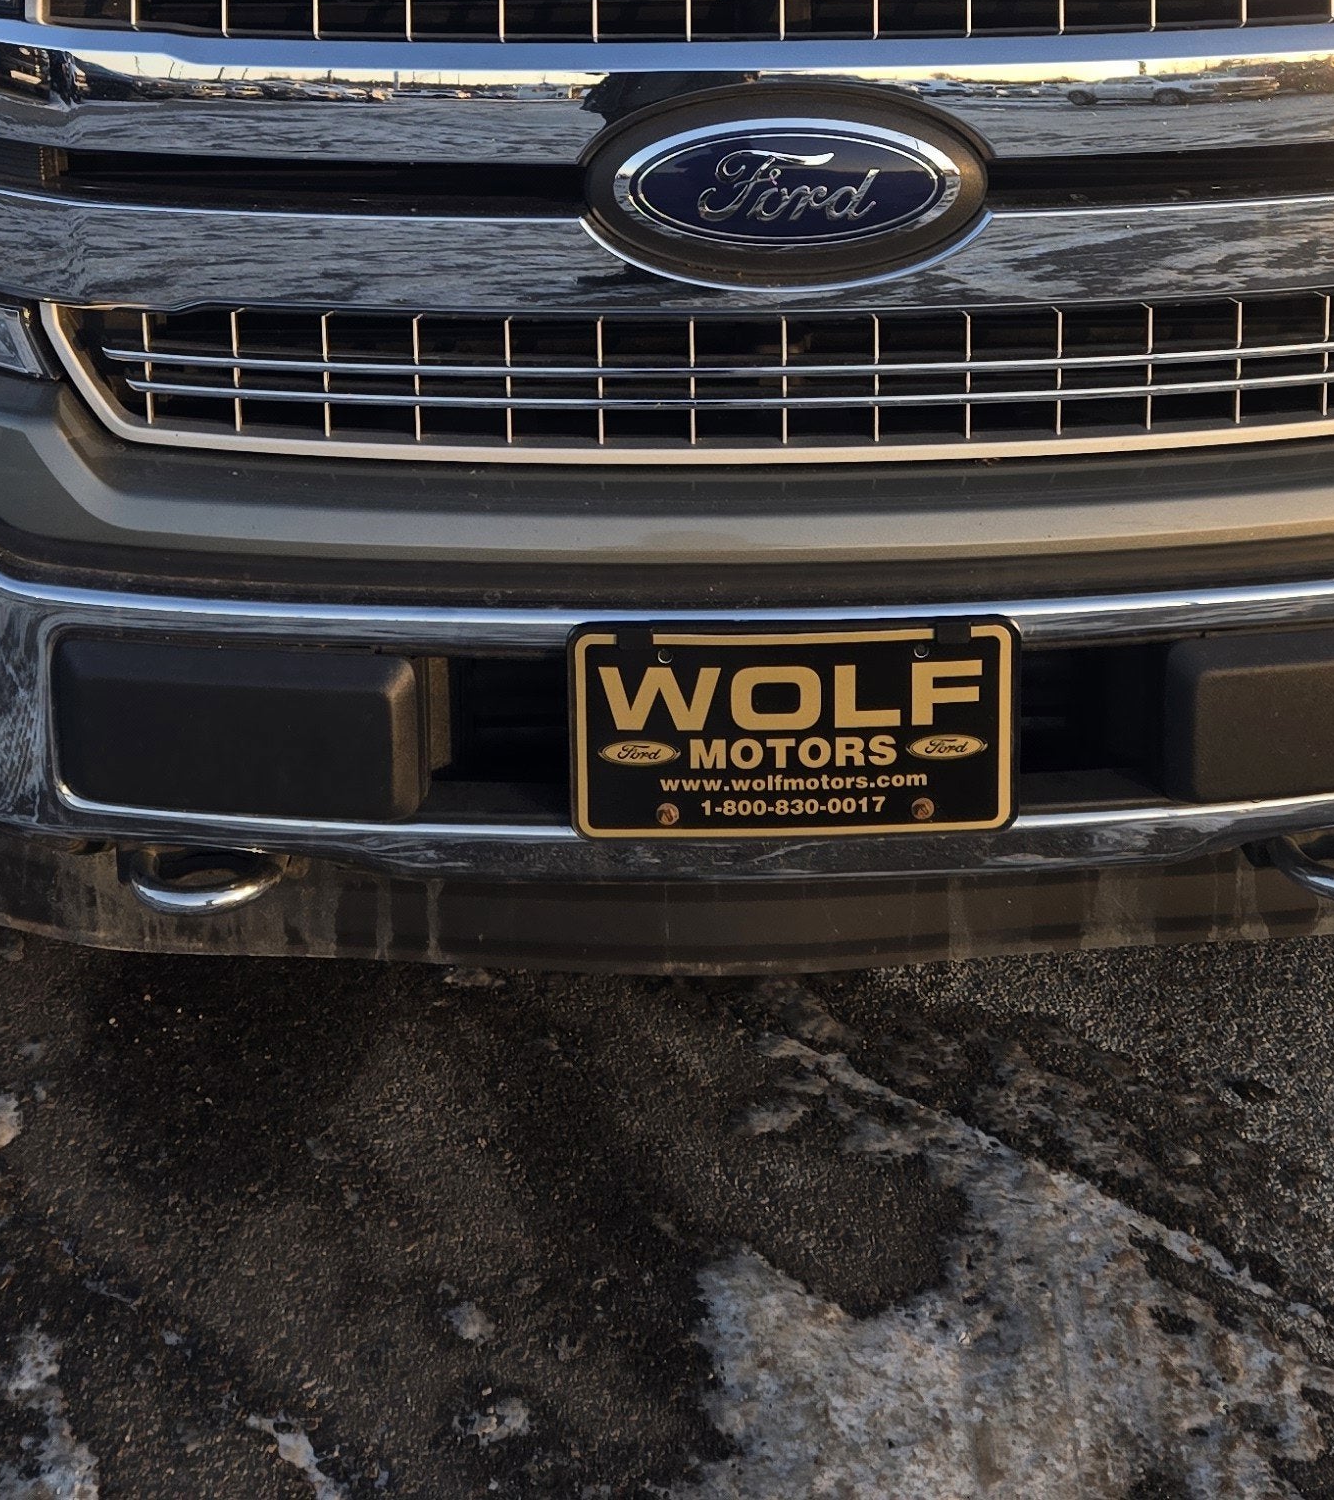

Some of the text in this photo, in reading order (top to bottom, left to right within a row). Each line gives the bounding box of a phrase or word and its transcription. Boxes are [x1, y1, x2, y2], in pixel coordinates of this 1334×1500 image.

[697, 149, 881, 222] Ford
[598, 659, 983, 731] WOLF
[616, 743, 662, 761] Ford
[689, 734, 898, 770] MOTORS
[923, 737, 969, 755] Ford
[660, 771, 928, 792] www.wolfmotors.com
[701, 796, 886, 816] 1-800-830-0017
